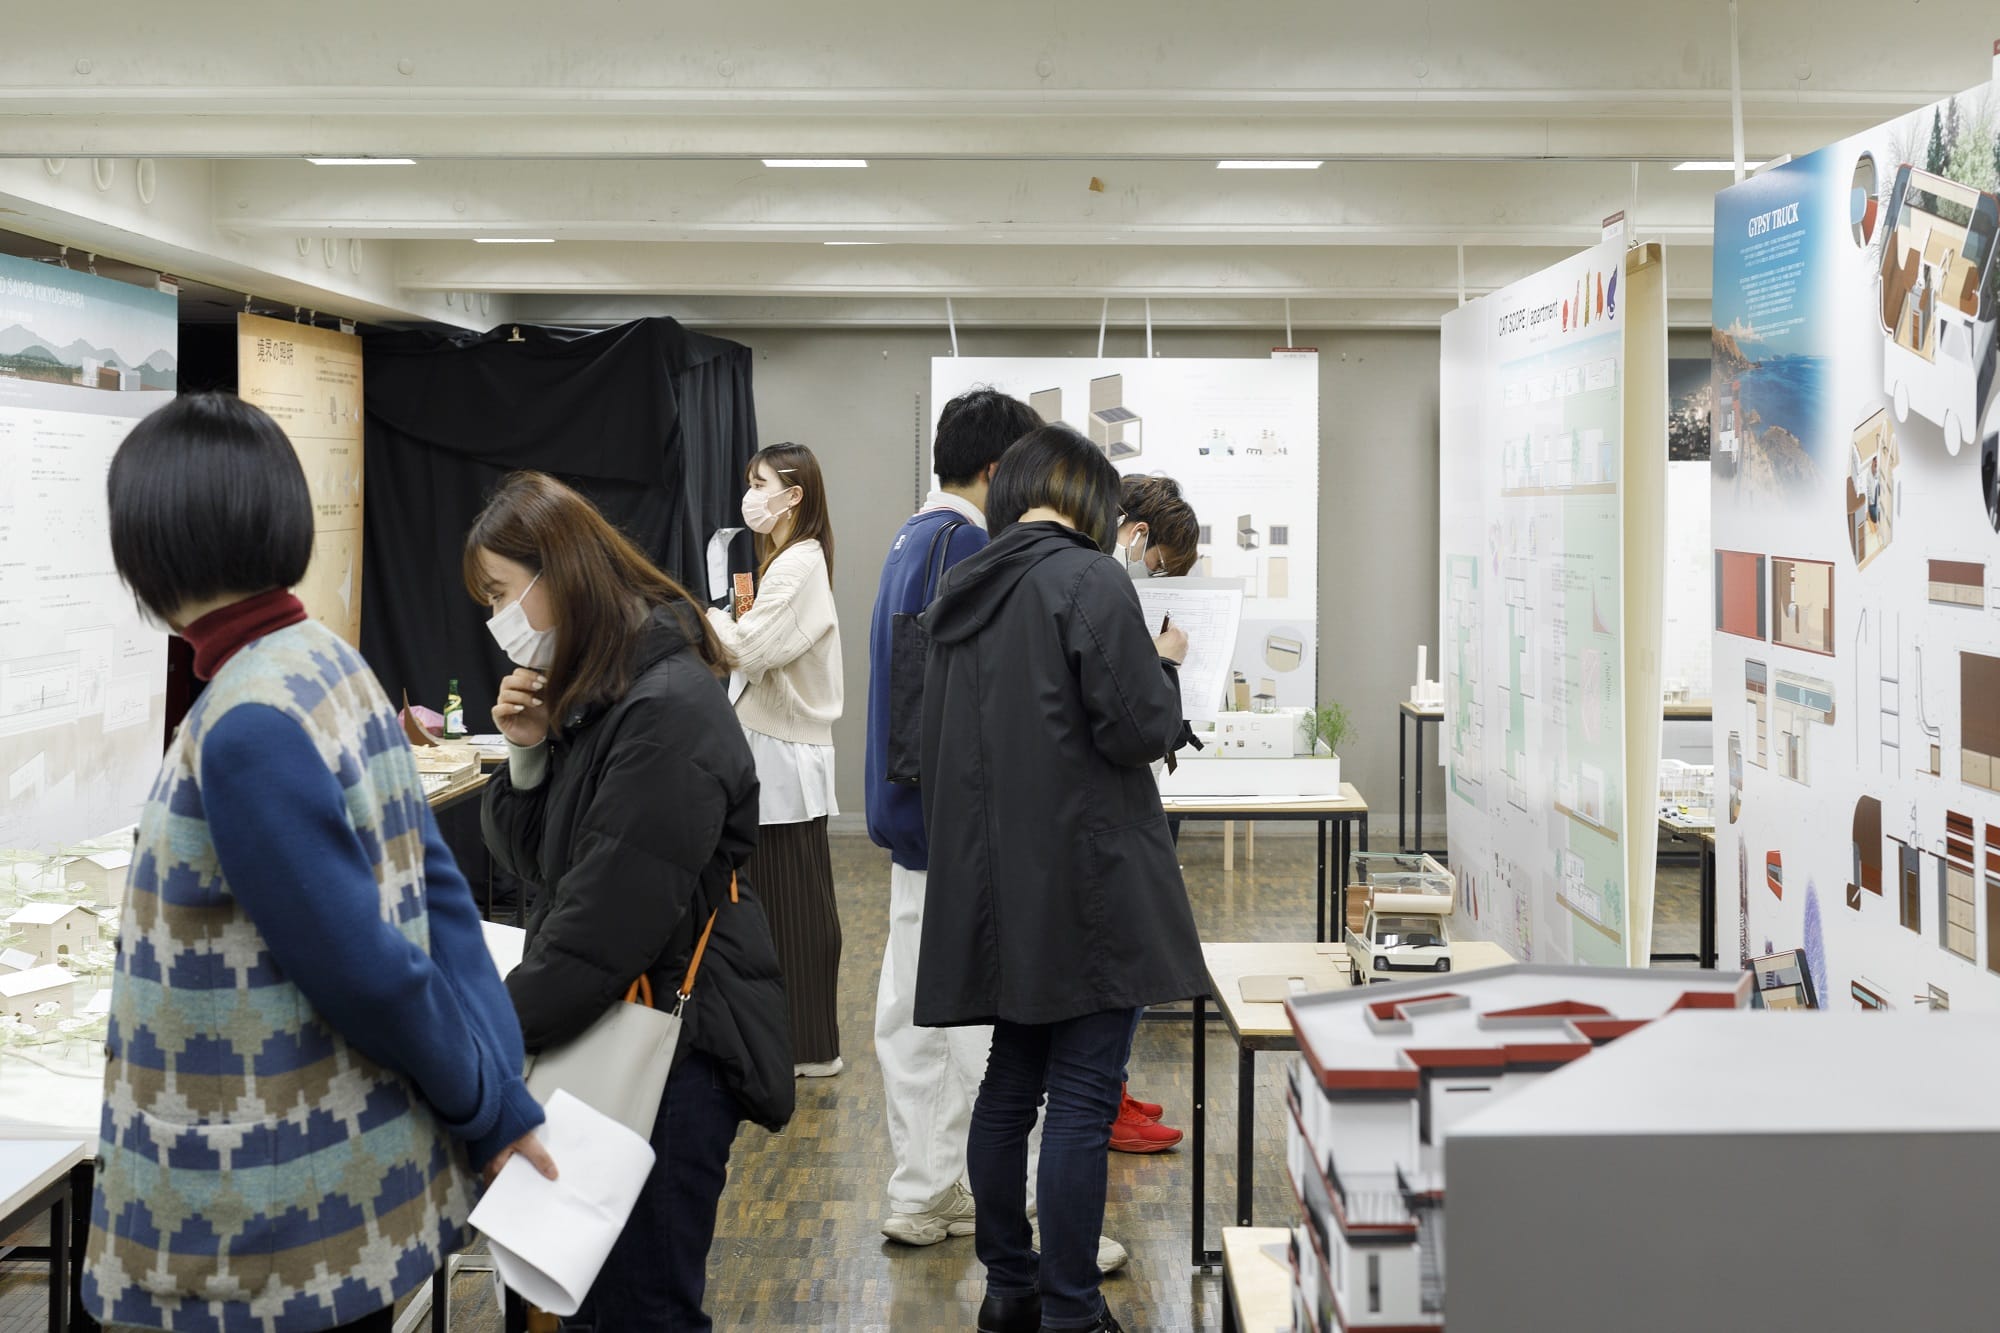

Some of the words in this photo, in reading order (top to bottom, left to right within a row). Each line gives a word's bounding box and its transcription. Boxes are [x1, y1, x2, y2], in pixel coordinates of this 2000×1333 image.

[1748, 212, 1771, 238] GYPSY
[1772, 202, 1800, 229] TRUCK
[1530, 299, 1558, 330] apartment
